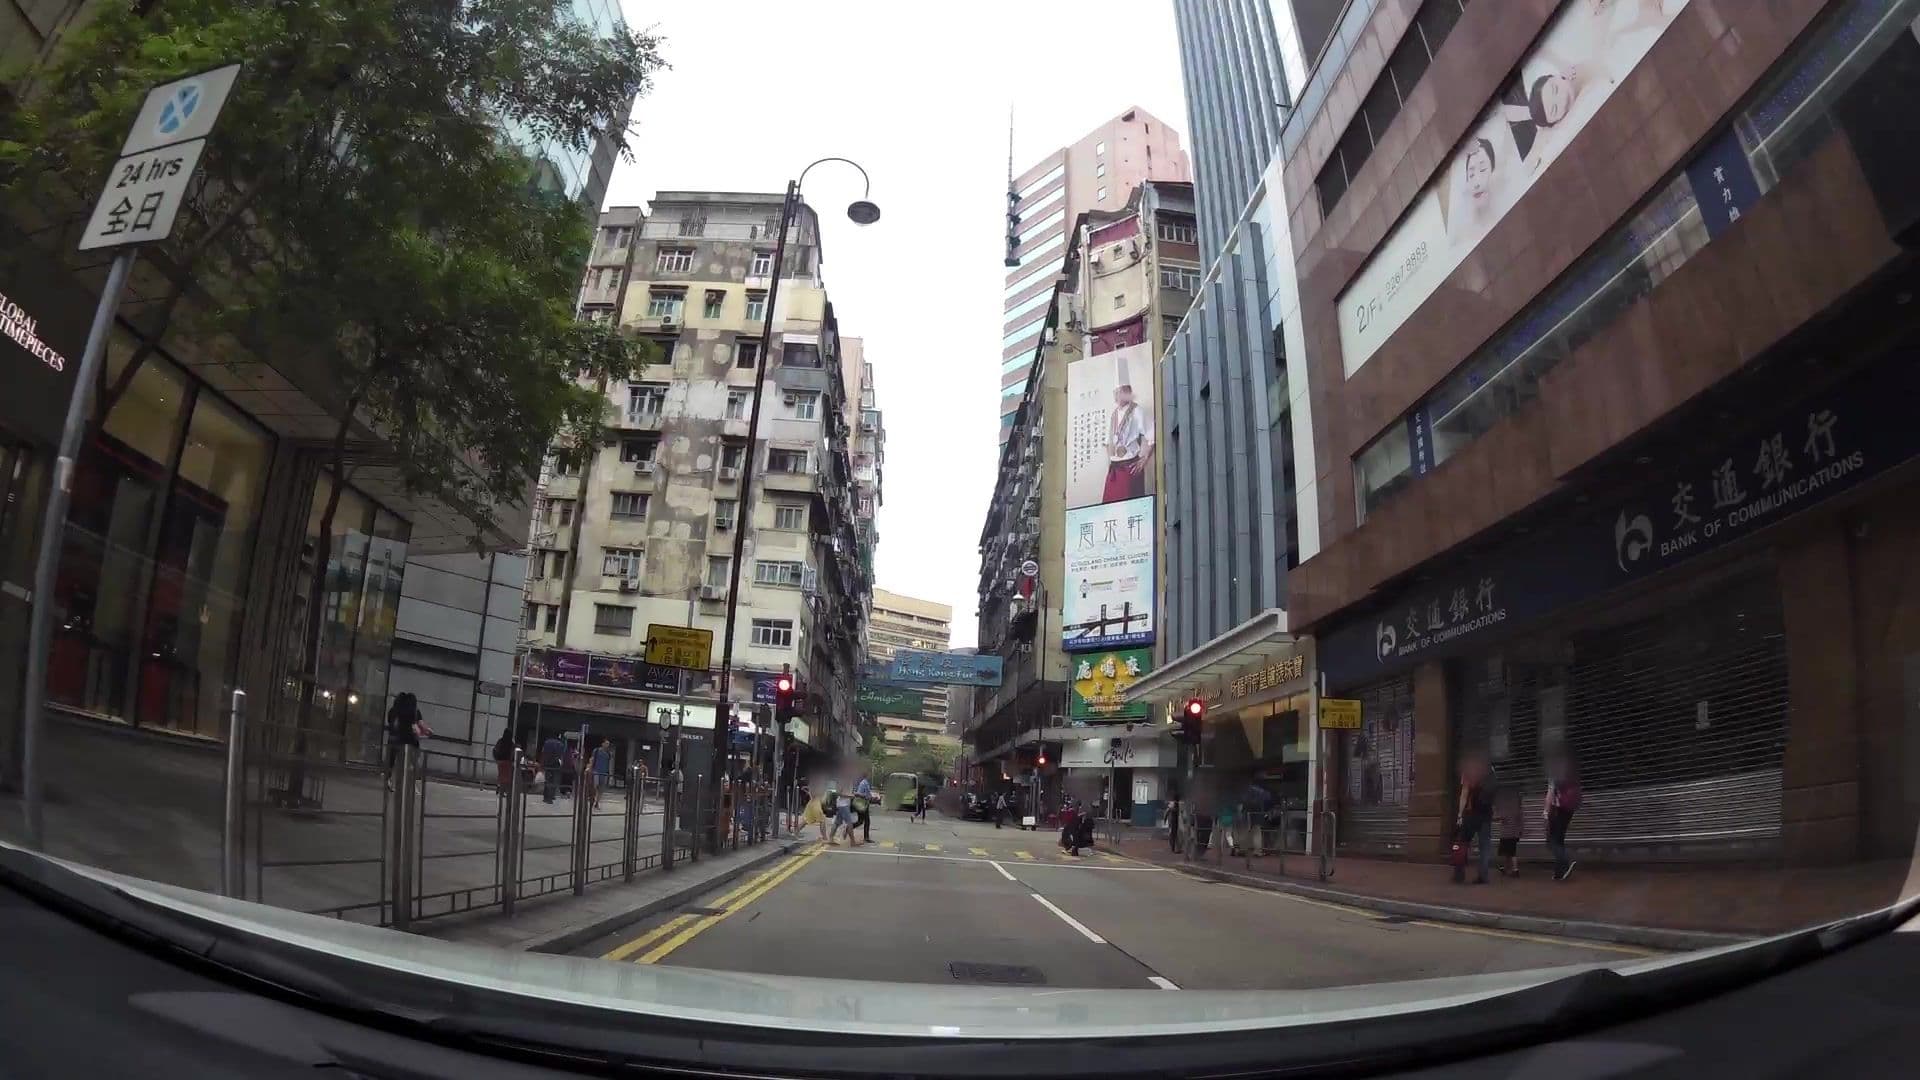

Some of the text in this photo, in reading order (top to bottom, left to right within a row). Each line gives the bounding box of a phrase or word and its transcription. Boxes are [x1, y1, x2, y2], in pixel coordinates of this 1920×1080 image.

[116, 157, 183, 188] 24 hrs
[100, 190, 164, 236] 全日
[1356, 297, 1377, 334] 2/F
[0, 313, 65, 372] TIMEPIECES
[1672, 410, 1838, 530] 交通銀行
[1660, 451, 1865, 557] BANK OF COMMUNICATIONS
[1399, 608, 1506, 656] BANK OF COMMUNICATIONS
[1406, 578, 1495, 640] 交通銀行
[898, 666, 924, 677] Hong
[929, 667, 956, 678] Kong
[860, 691, 903, 705] Amigo
[1111, 694, 1128, 703] DEE
